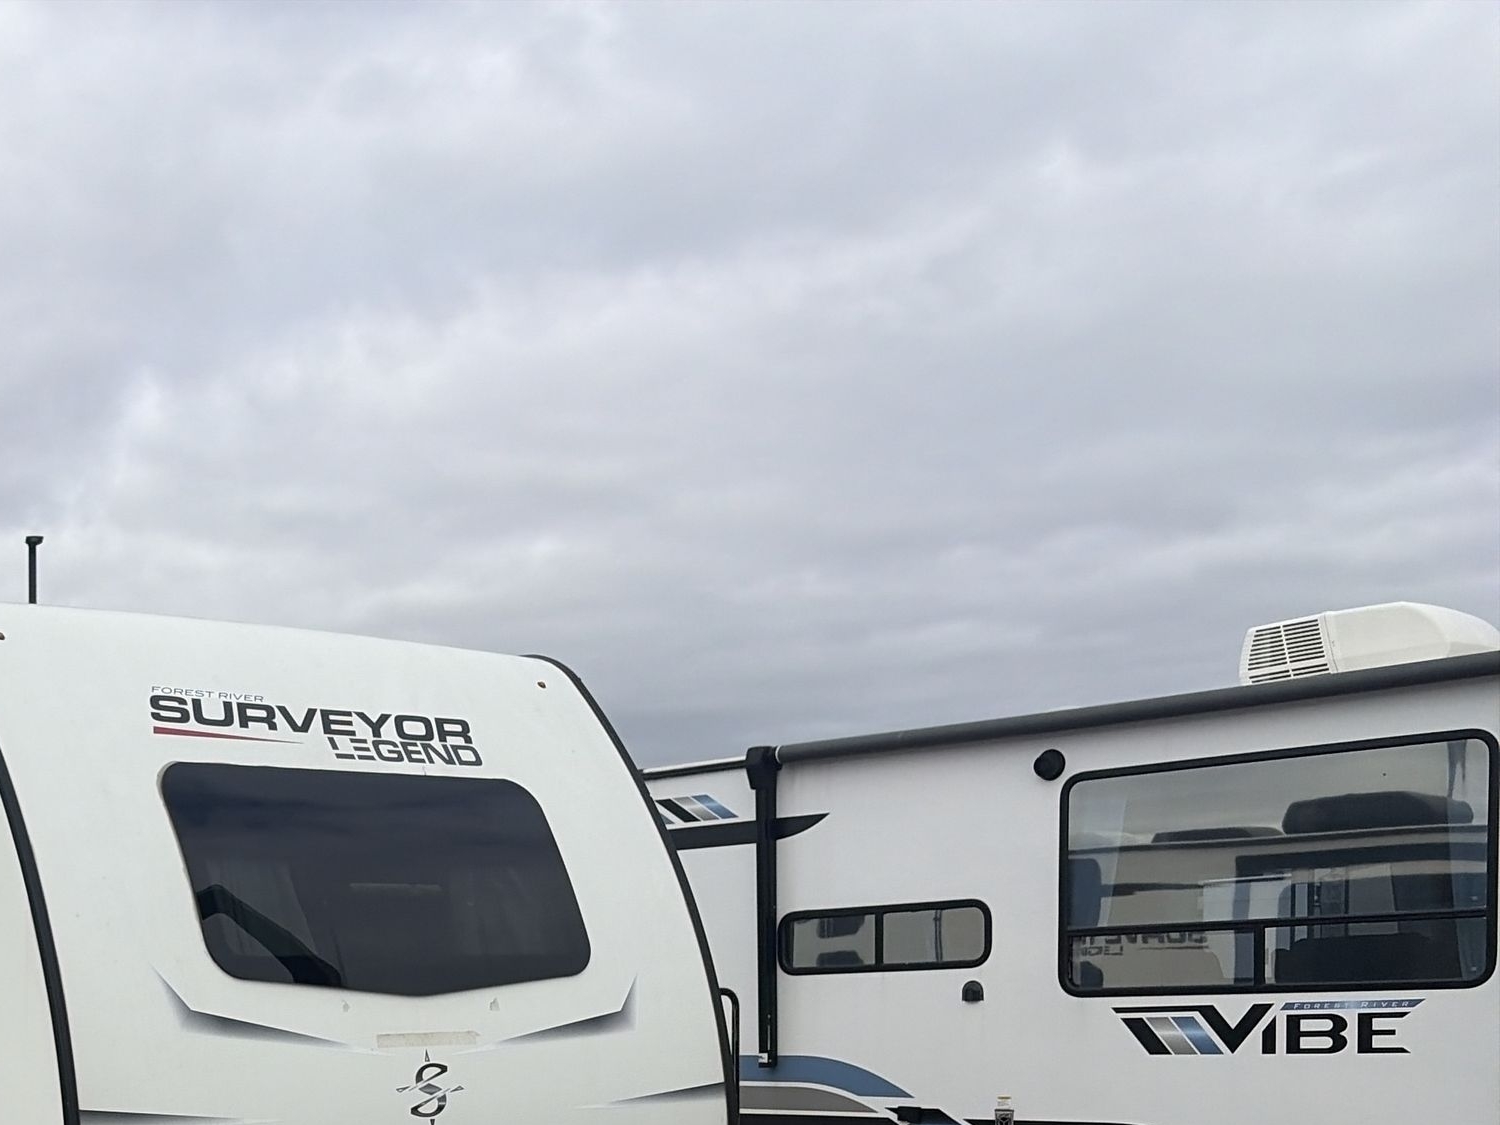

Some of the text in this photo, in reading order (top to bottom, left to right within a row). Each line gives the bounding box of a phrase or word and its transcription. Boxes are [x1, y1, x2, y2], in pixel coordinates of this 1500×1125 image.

[151, 686, 264, 702] FOREST RIVER
[150, 695, 473, 744] SURVEYOR
[327, 736, 483, 766] LEGEND
[1293, 1000, 1409, 1010] FOREST RIVER
[1180, 1001, 1412, 1054] VIBE
